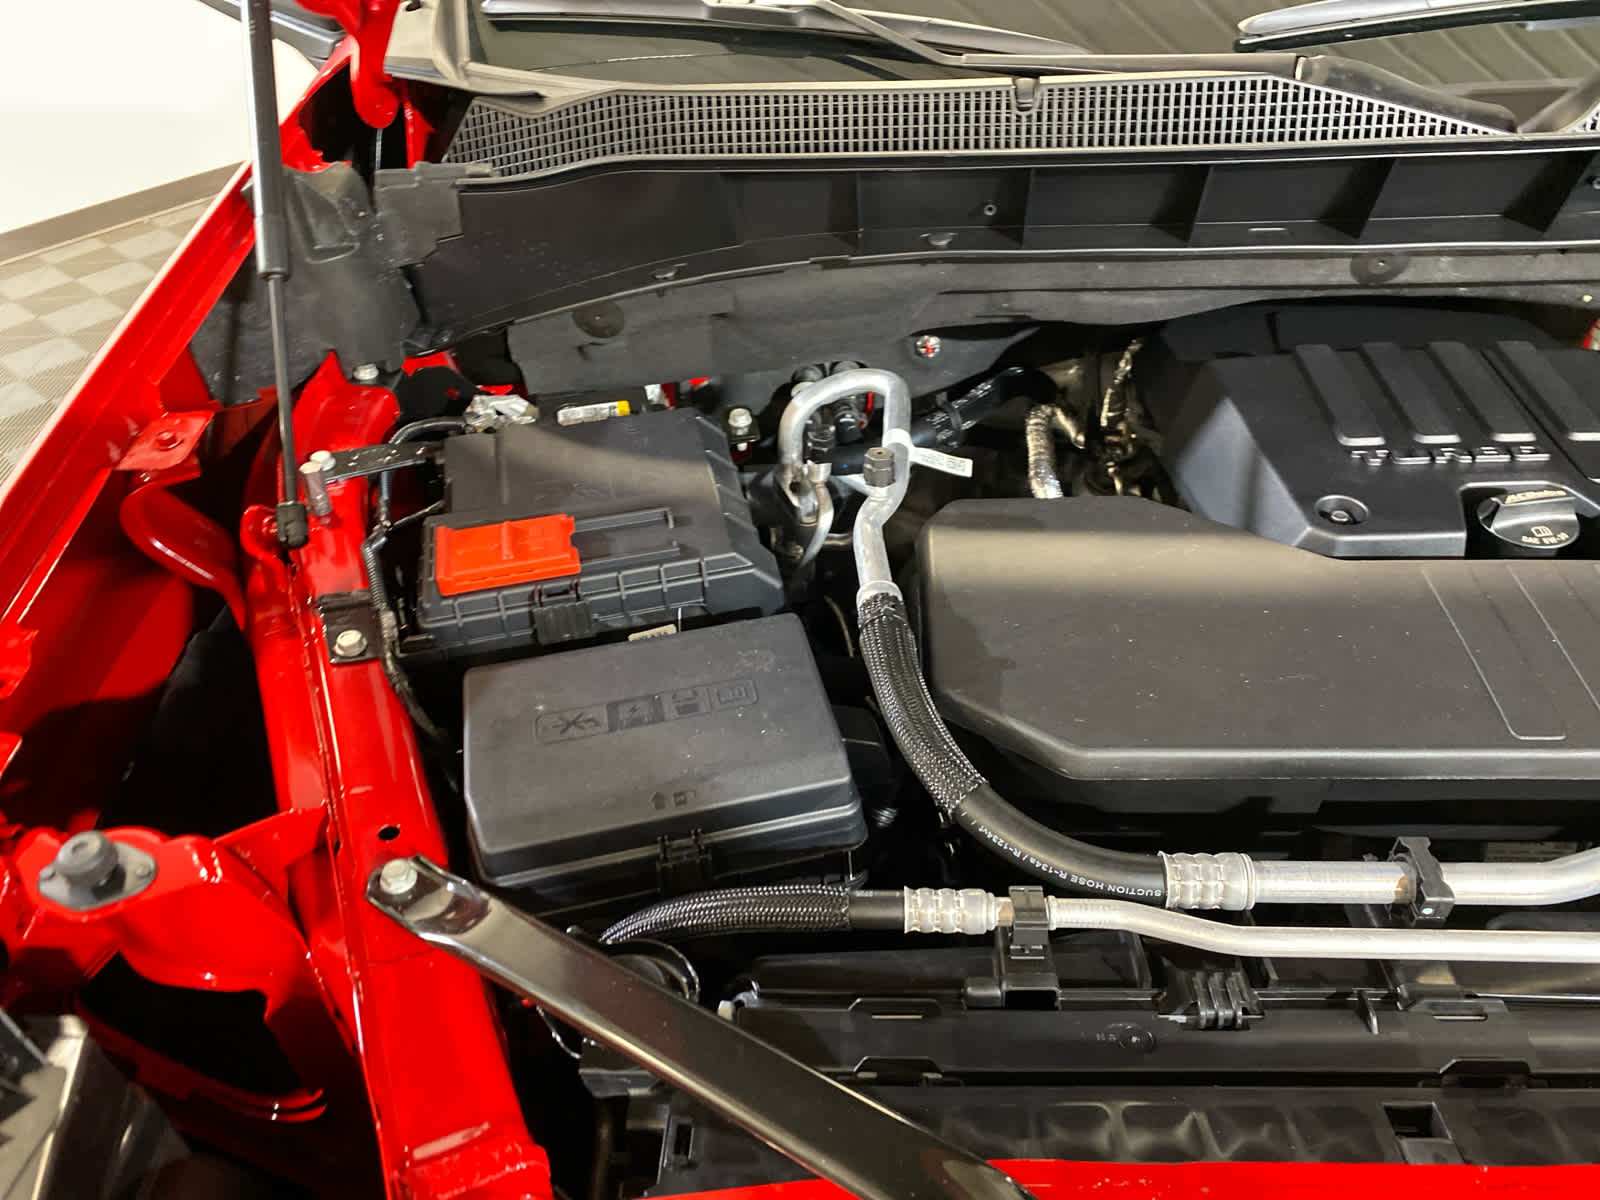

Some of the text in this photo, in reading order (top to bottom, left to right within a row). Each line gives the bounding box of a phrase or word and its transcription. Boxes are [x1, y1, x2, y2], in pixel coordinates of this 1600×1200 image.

[1029, 858, 1068, 880] R-134a
[1070, 873, 1104, 890] HOSE
[1107, 883, 1162, 897] SUCTION
